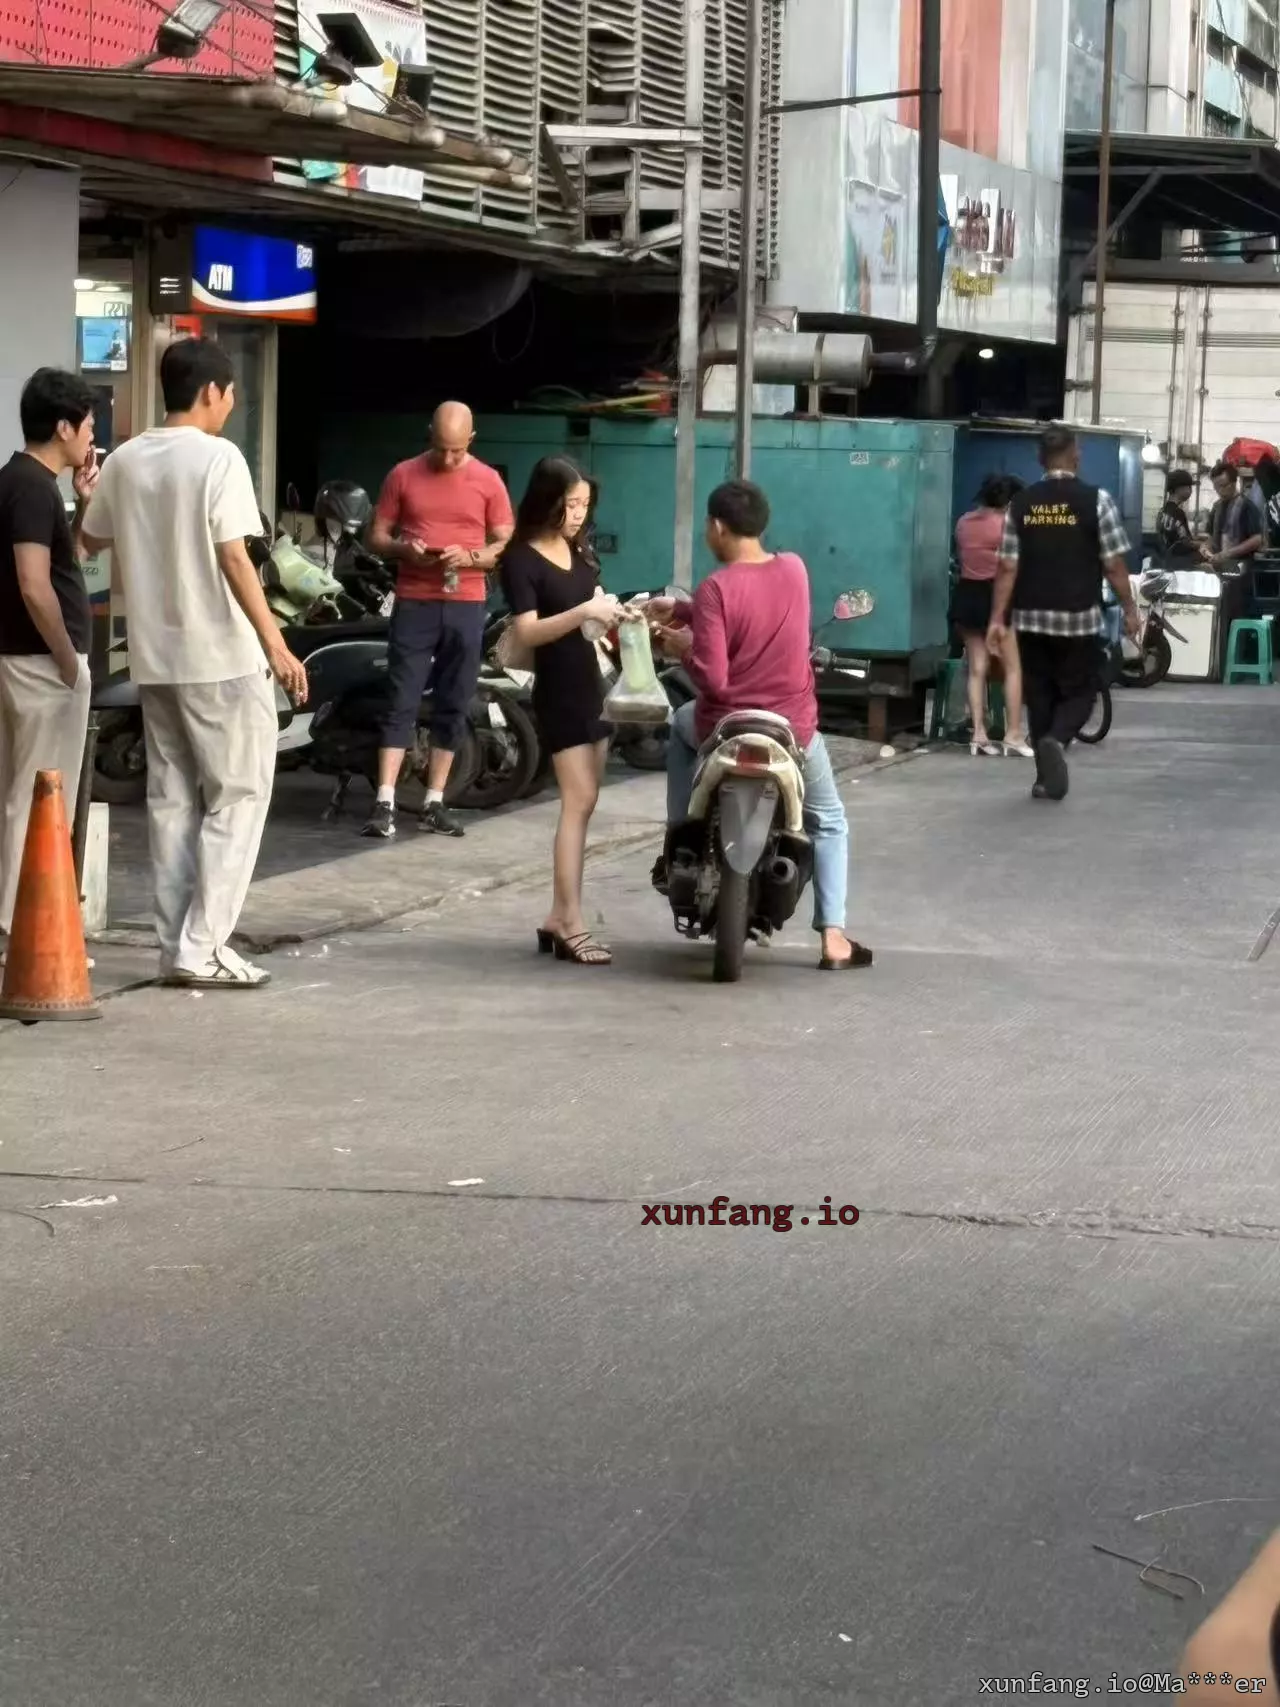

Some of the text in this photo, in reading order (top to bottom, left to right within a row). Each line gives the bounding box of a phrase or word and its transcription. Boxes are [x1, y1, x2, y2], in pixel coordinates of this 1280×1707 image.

[208, 264, 233, 291] ATM
[1031, 503, 1069, 514] VALET
[1023, 514, 1077, 526] PARKING
